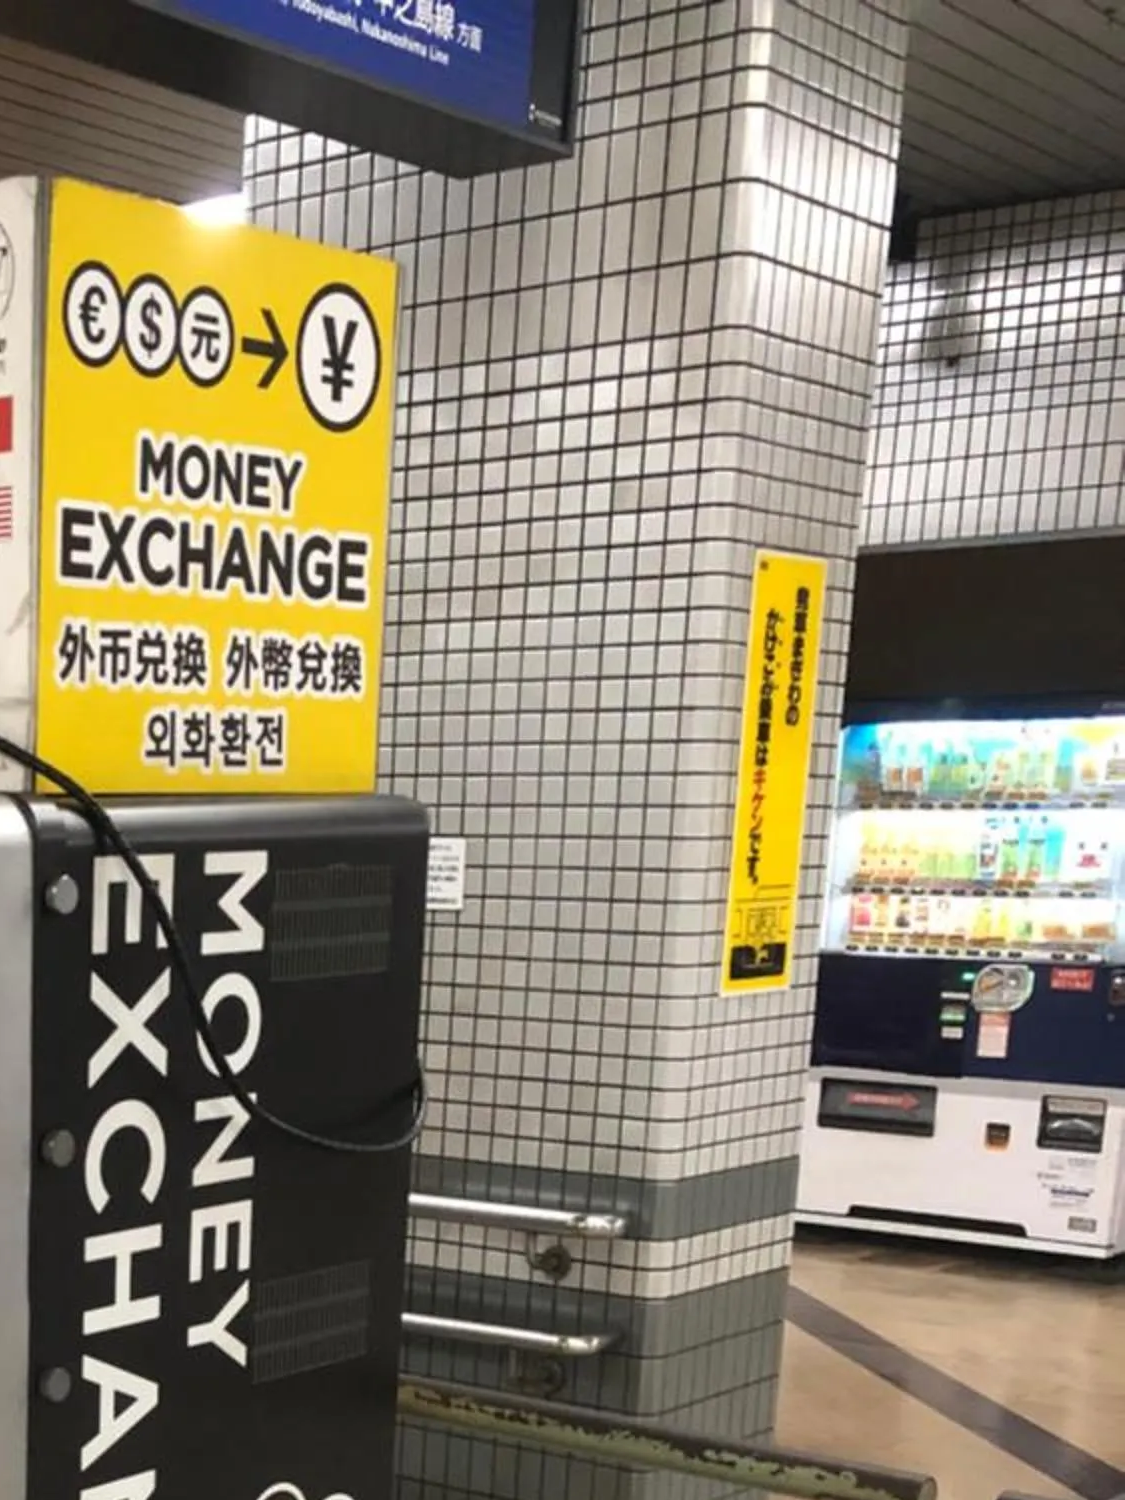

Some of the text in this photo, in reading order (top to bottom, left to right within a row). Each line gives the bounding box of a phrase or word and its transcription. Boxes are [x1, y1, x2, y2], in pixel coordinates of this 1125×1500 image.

[139, 437, 303, 511] MONEY
[59, 506, 369, 602] EXCHANGE
[58, 623, 207, 688] 外币兑换
[144, 709, 285, 768] 외화환전
[186, 850, 269, 1368] MONEY
